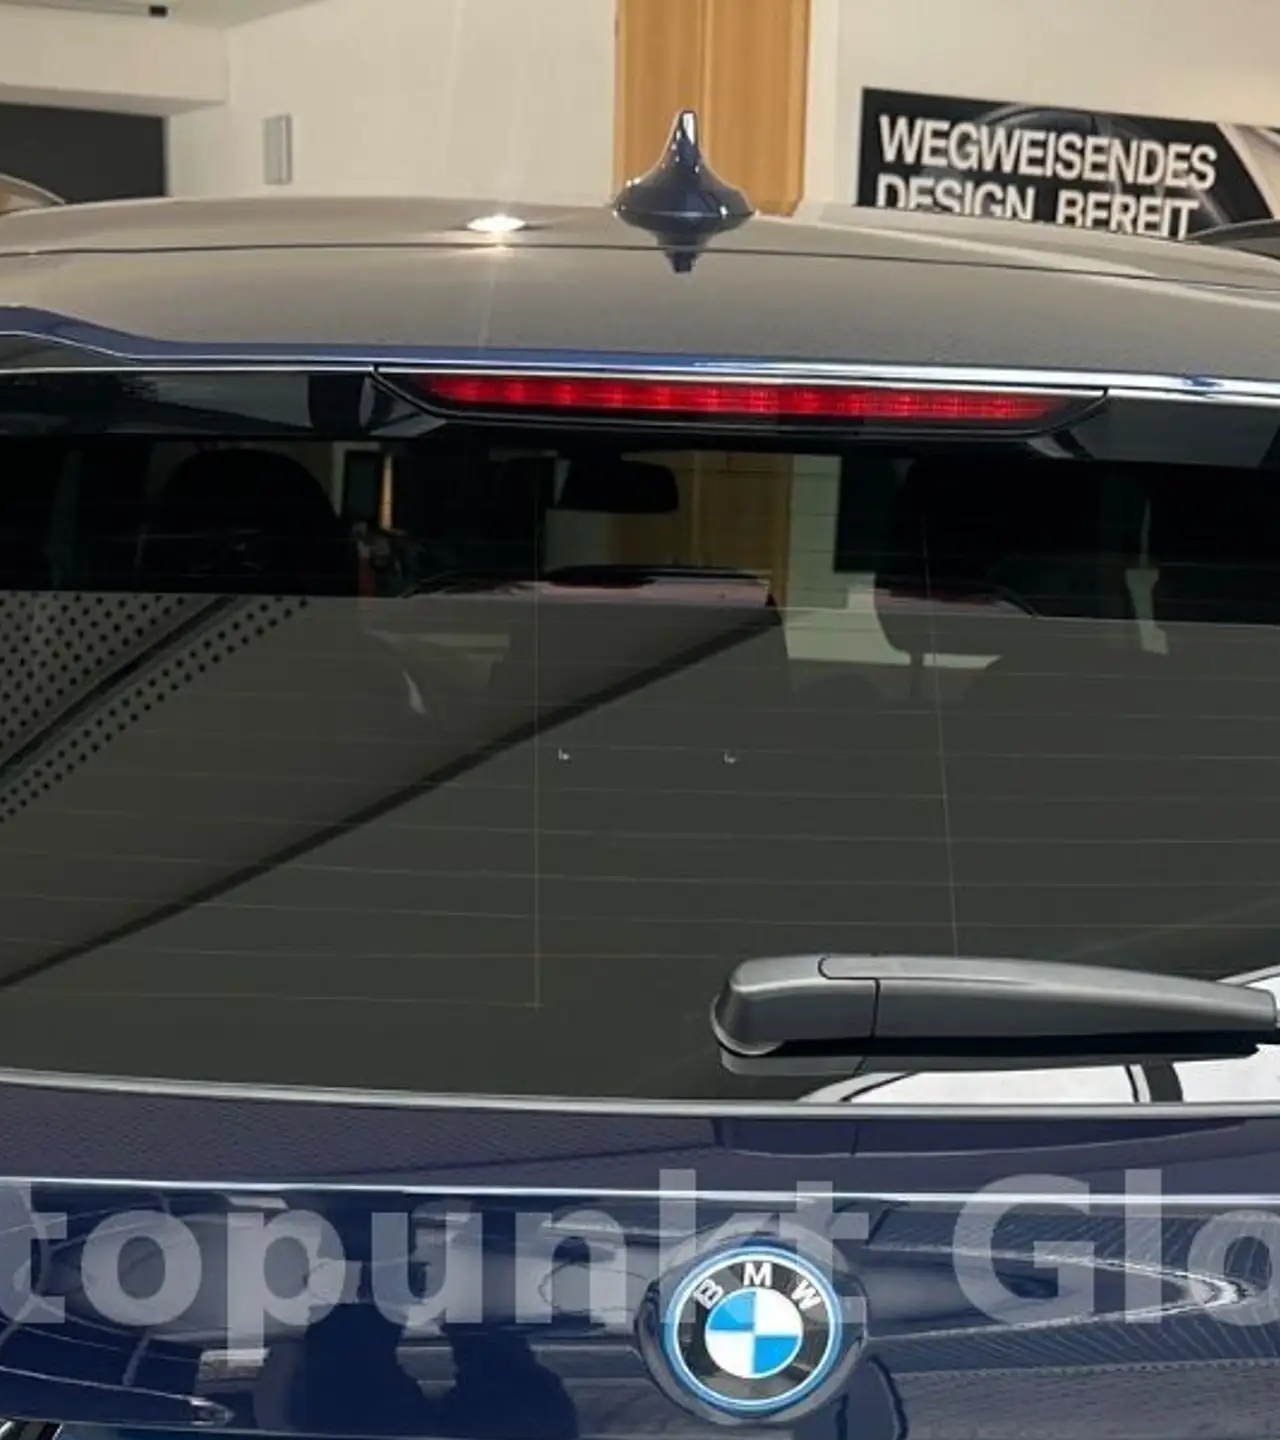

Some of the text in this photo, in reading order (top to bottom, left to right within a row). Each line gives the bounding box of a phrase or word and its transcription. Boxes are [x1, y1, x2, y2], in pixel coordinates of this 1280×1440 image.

[878, 113, 1218, 191] WEGWEISENDES
[1055, 188, 1200, 242] BEREIT
[692, 1261, 822, 1311] BMW
